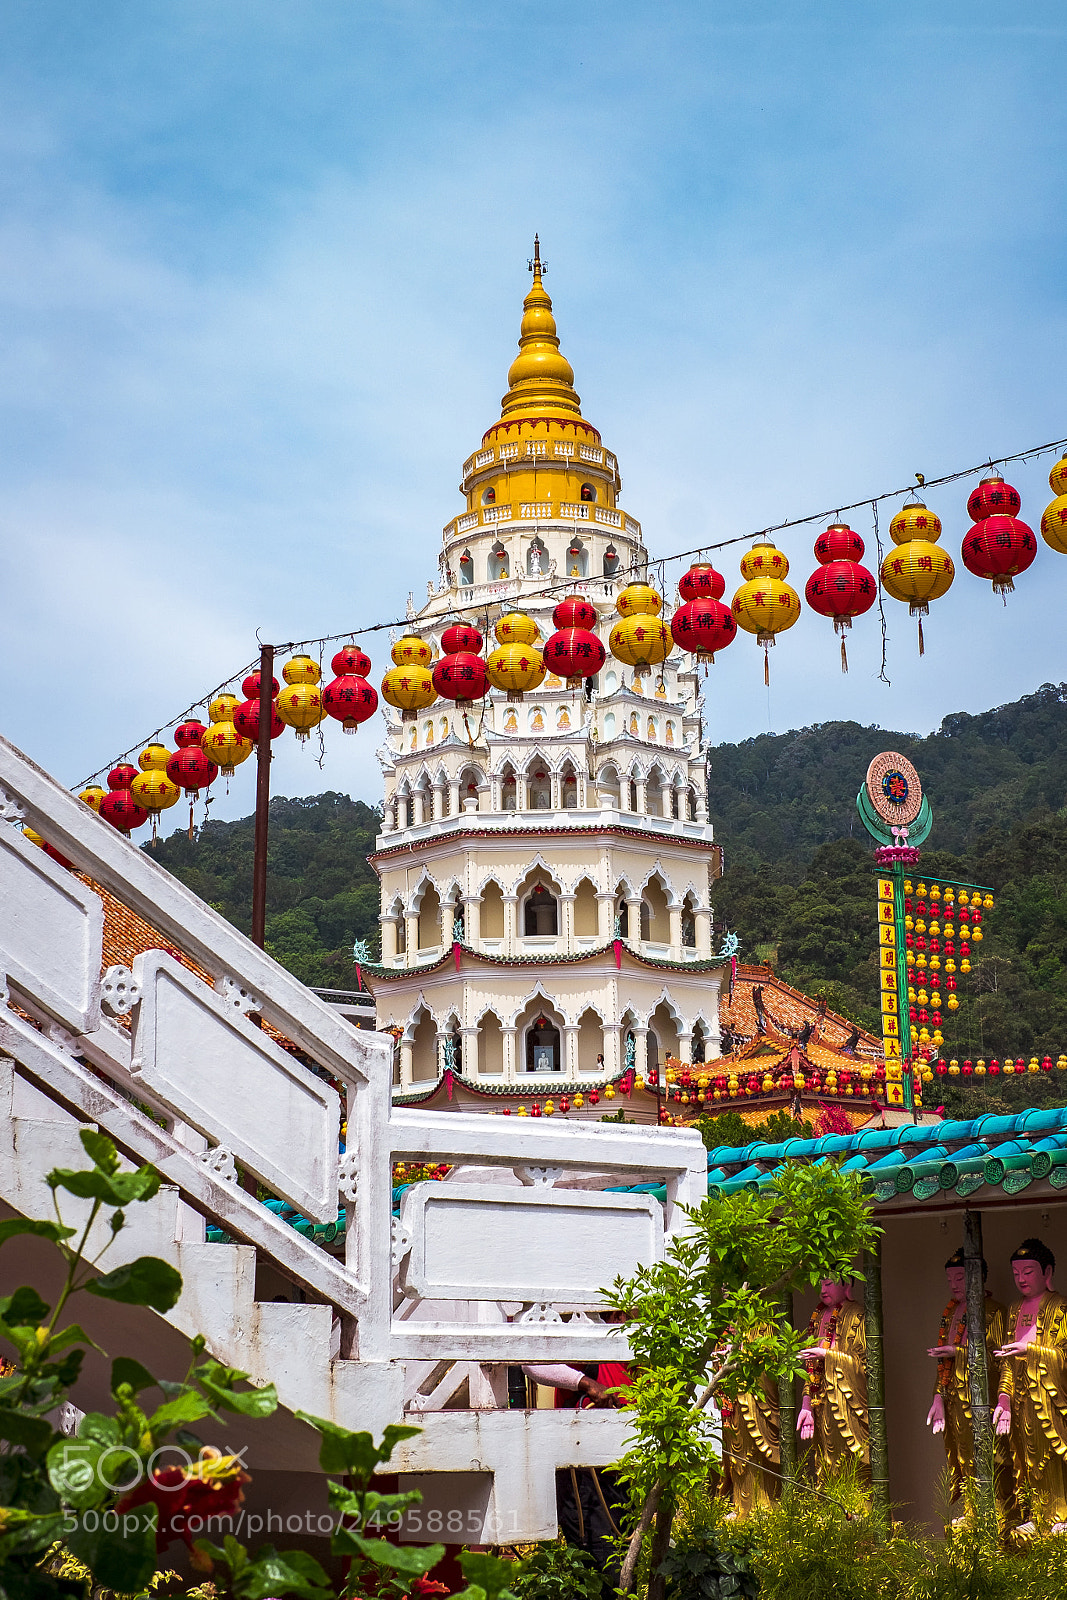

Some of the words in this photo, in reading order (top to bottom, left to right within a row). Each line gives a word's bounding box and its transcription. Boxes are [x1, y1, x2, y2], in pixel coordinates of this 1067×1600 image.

[884, 883, 902, 1101] 萬佛光明燈吉祥大會
